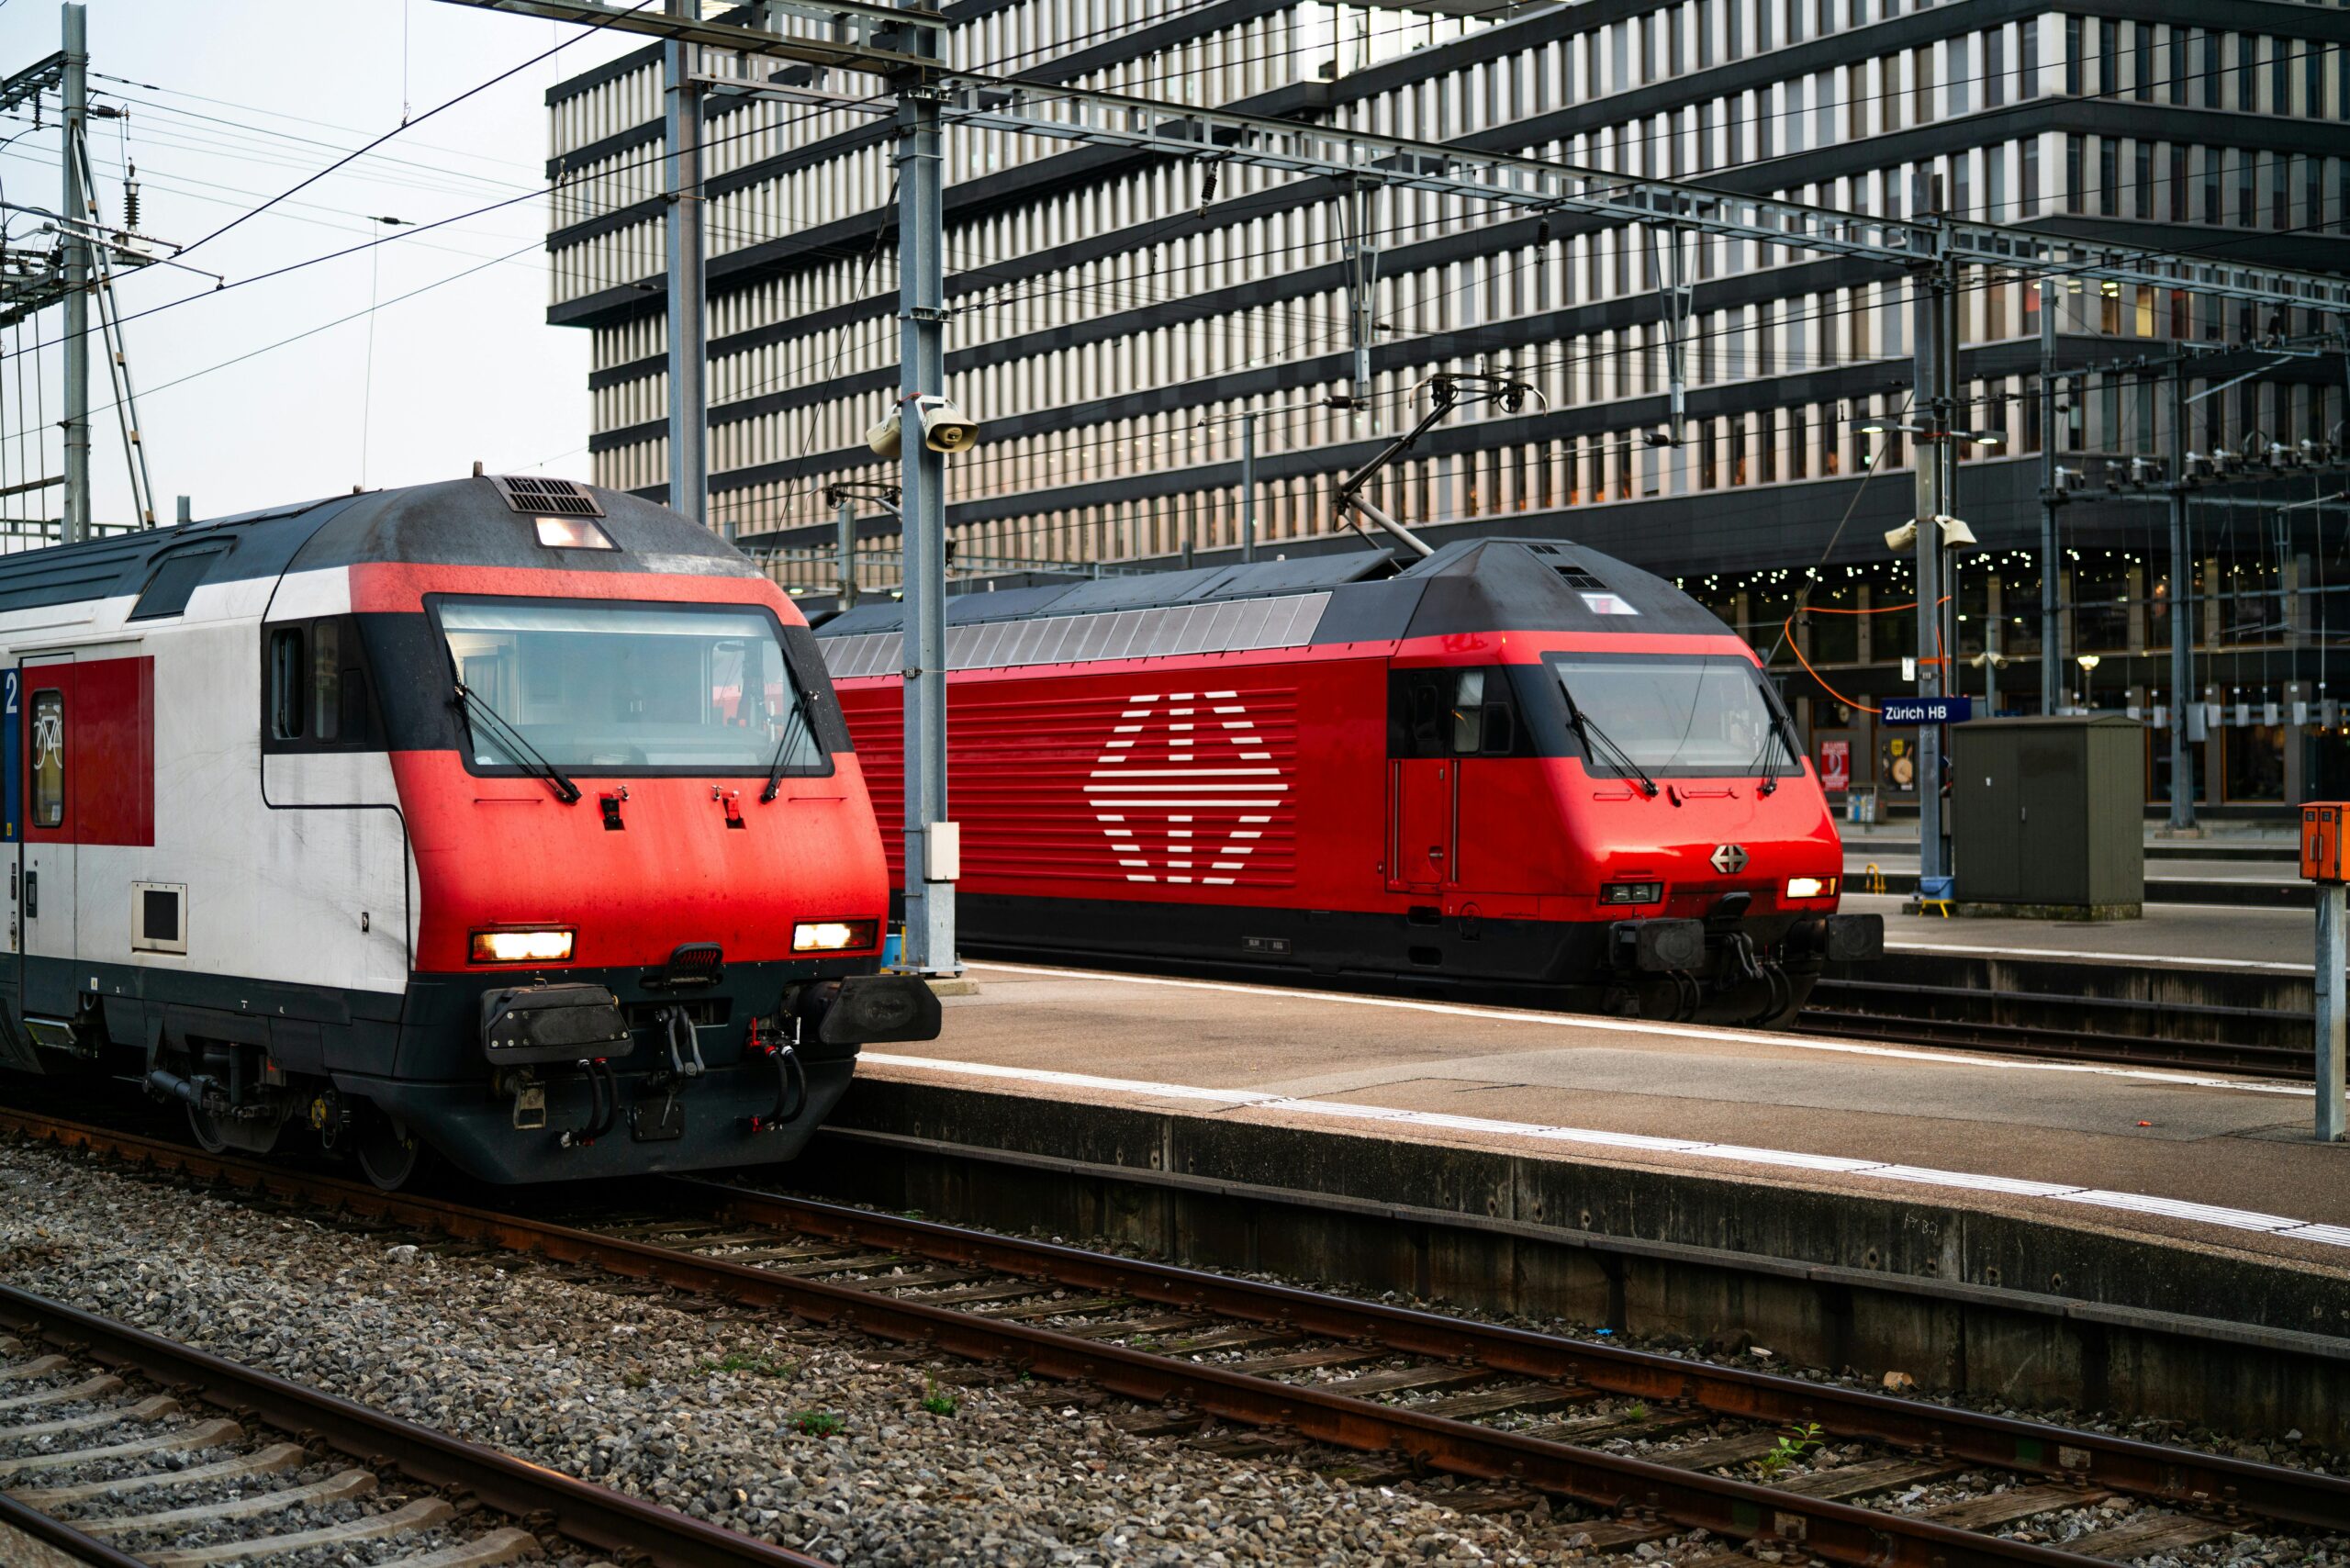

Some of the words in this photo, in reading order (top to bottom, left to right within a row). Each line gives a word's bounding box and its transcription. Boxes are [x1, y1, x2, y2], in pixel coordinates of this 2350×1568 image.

[6, 671, 17, 714] 2
[1885, 705, 1924, 721] Zürich
[1928, 705, 1947, 720] HB
